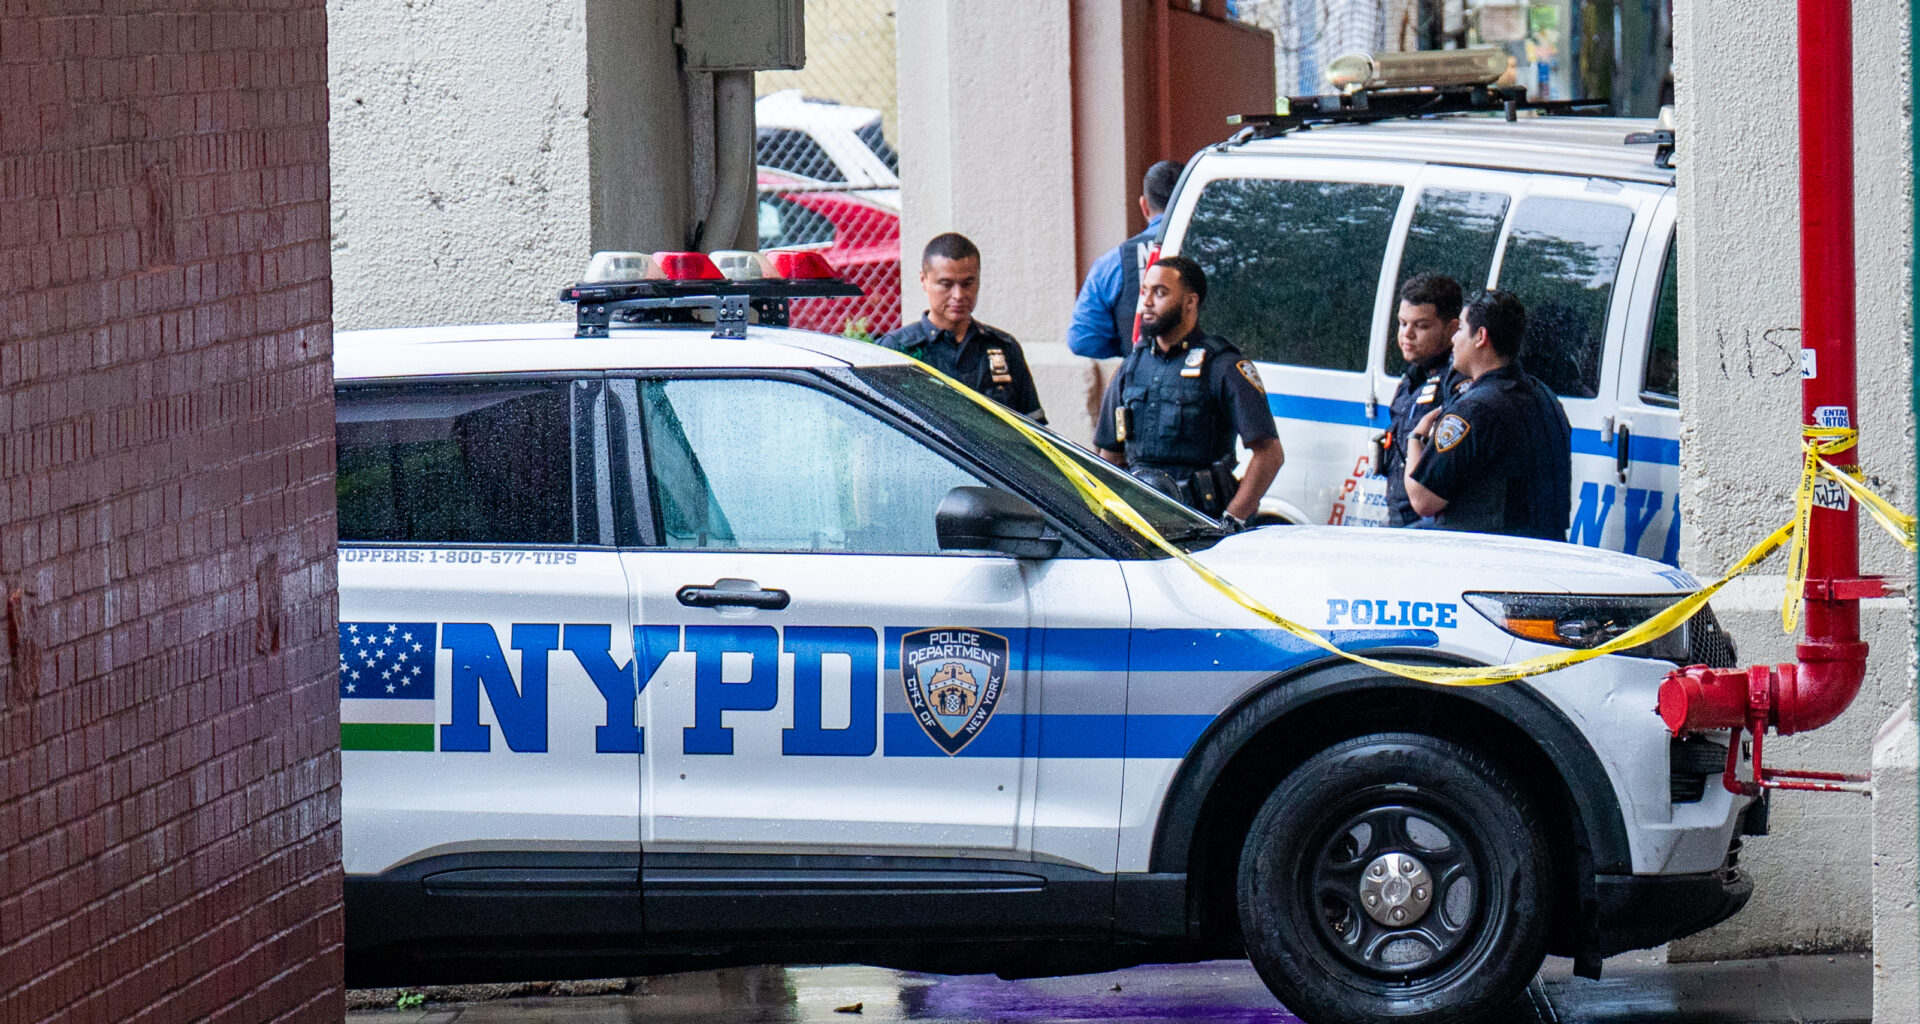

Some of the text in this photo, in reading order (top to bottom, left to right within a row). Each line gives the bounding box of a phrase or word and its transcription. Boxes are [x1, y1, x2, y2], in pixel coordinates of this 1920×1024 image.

[1822, 416, 1849, 427] RTOS
[1568, 481, 1680, 570] NY
[428, 550, 578, 565] 1-800-577-TIPS
[1326, 598, 1458, 629] POLICE
[929, 632, 980, 647] POLICE
[908, 644, 1000, 669] DEPARTMENT
[440, 622, 878, 757] NYPD
[907, 675, 1001, 734] CITY OF NEW YORK
